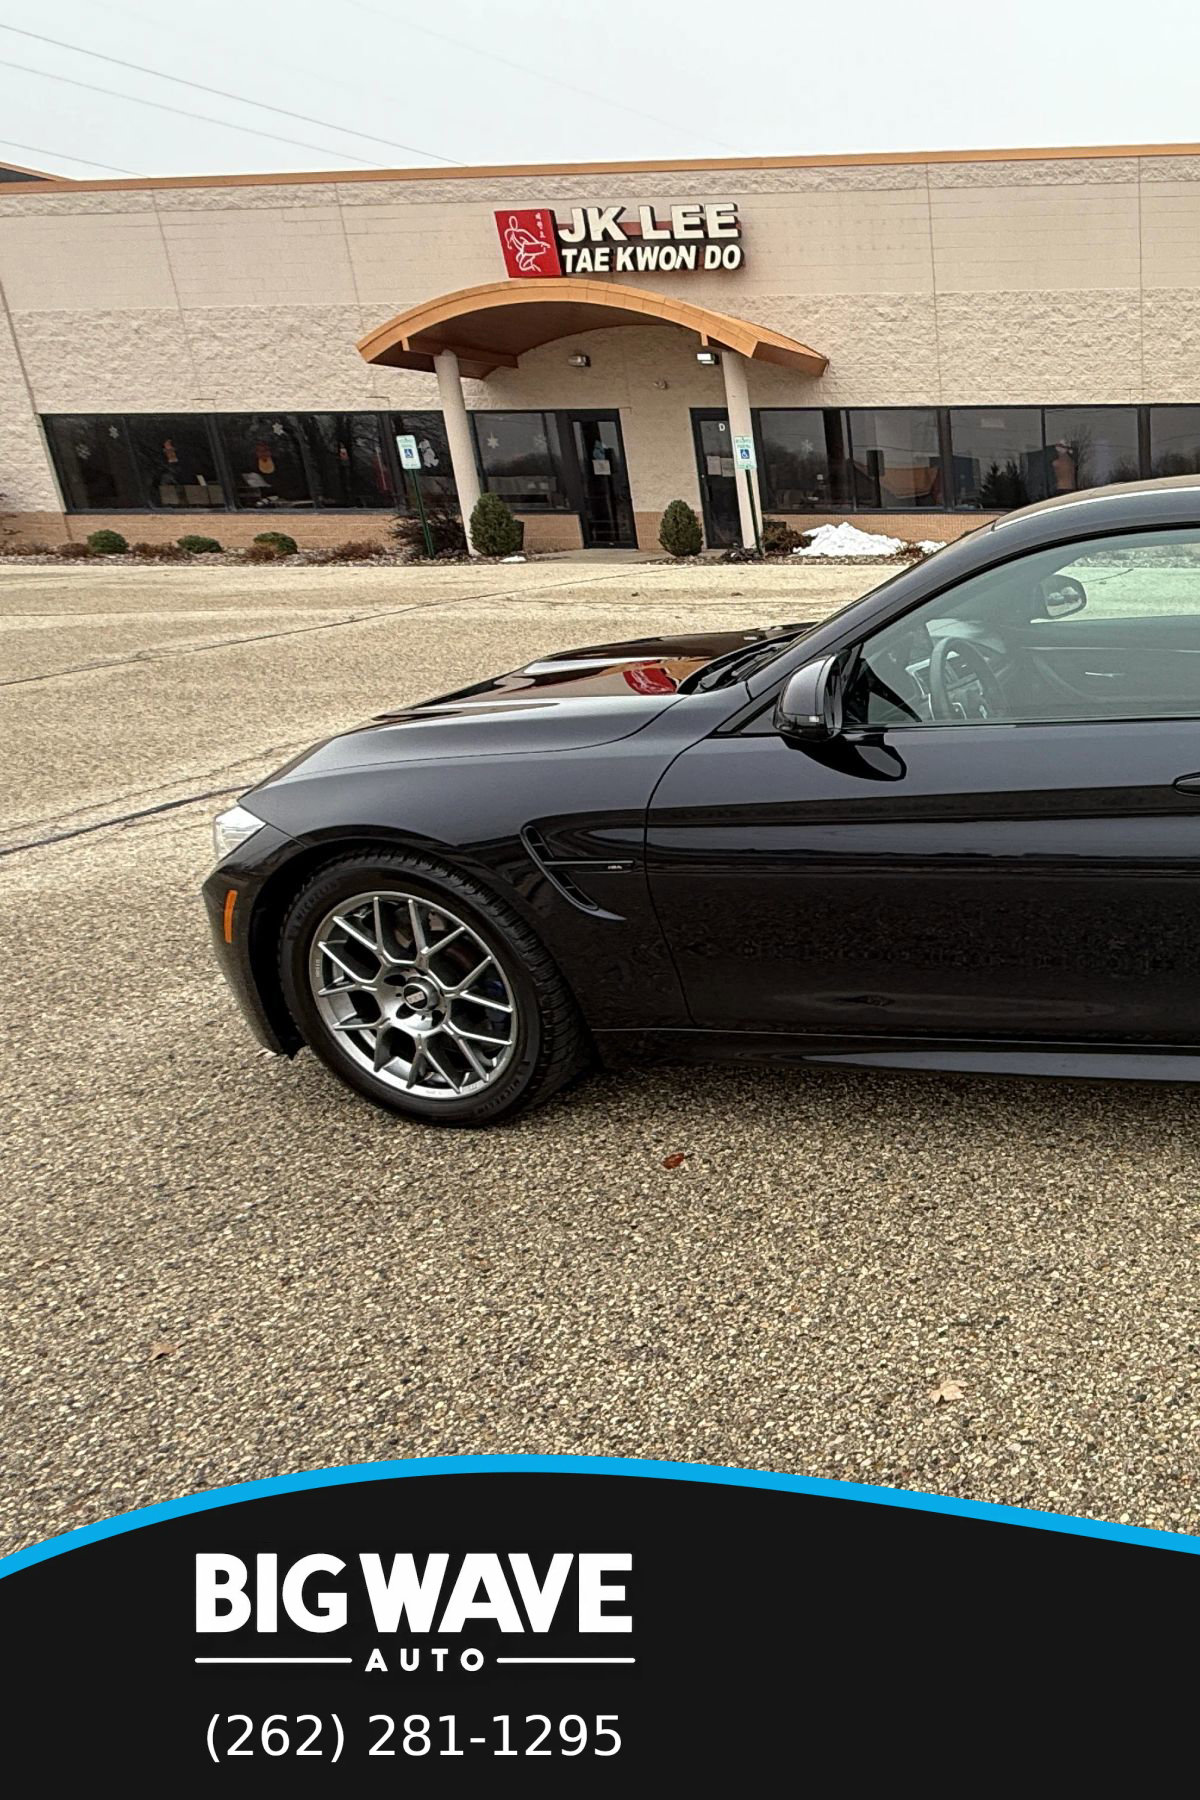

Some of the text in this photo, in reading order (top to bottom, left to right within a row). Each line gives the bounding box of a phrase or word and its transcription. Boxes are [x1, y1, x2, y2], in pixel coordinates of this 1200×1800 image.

[558, 206, 628, 243] JK
[638, 203, 740, 240] LEE
[561, 244, 741, 273] TAE KWON DO
